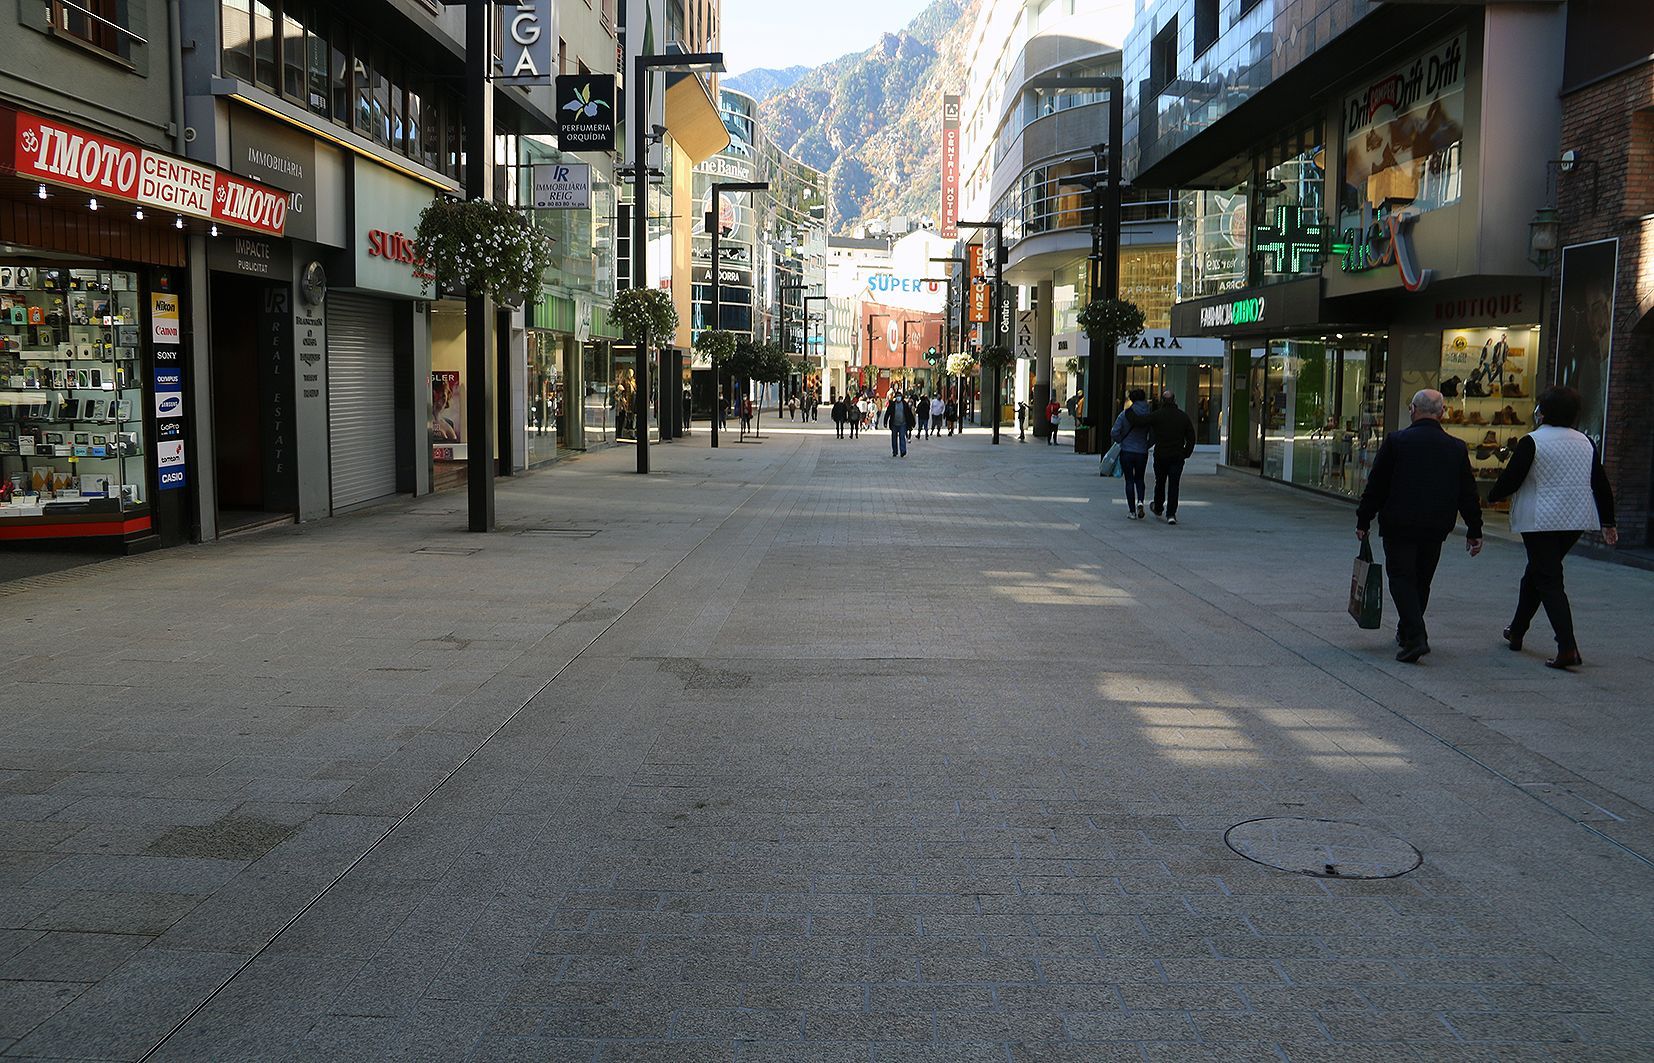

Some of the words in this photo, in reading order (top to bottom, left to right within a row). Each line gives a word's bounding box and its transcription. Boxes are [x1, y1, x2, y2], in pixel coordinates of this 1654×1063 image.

[562, 124, 611, 132] PERFUMERIA
[567, 133, 606, 141] ORQUÍDIA
[34, 125, 137, 192] IMOTO
[947, 131, 955, 182] CENTRIC
[143, 157, 213, 191] CENTRE
[553, 165, 570, 182] IR
[717, 158, 750, 179] Banker
[143, 178, 208, 211] DIGITAL
[549, 191, 573, 200] REIG
[222, 181, 286, 229] IMOTO
[946, 187, 954, 223] HOTEL
[235, 238, 270, 259] IMPACTE
[238, 260, 268, 273] PUBLICITAT
[868, 276, 921, 292] SUPER
[155, 300, 175, 312] Nikon
[1435, 294, 1522, 320] BOUTIQUE
[155, 325, 177, 336] Canon
[1018, 311, 1032, 358] ZARA
[1127, 336, 1182, 349] ZARA
[157, 351, 177, 359] SONY
[160, 423, 180, 431] GoPro
[162, 472, 183, 483] CASIO
